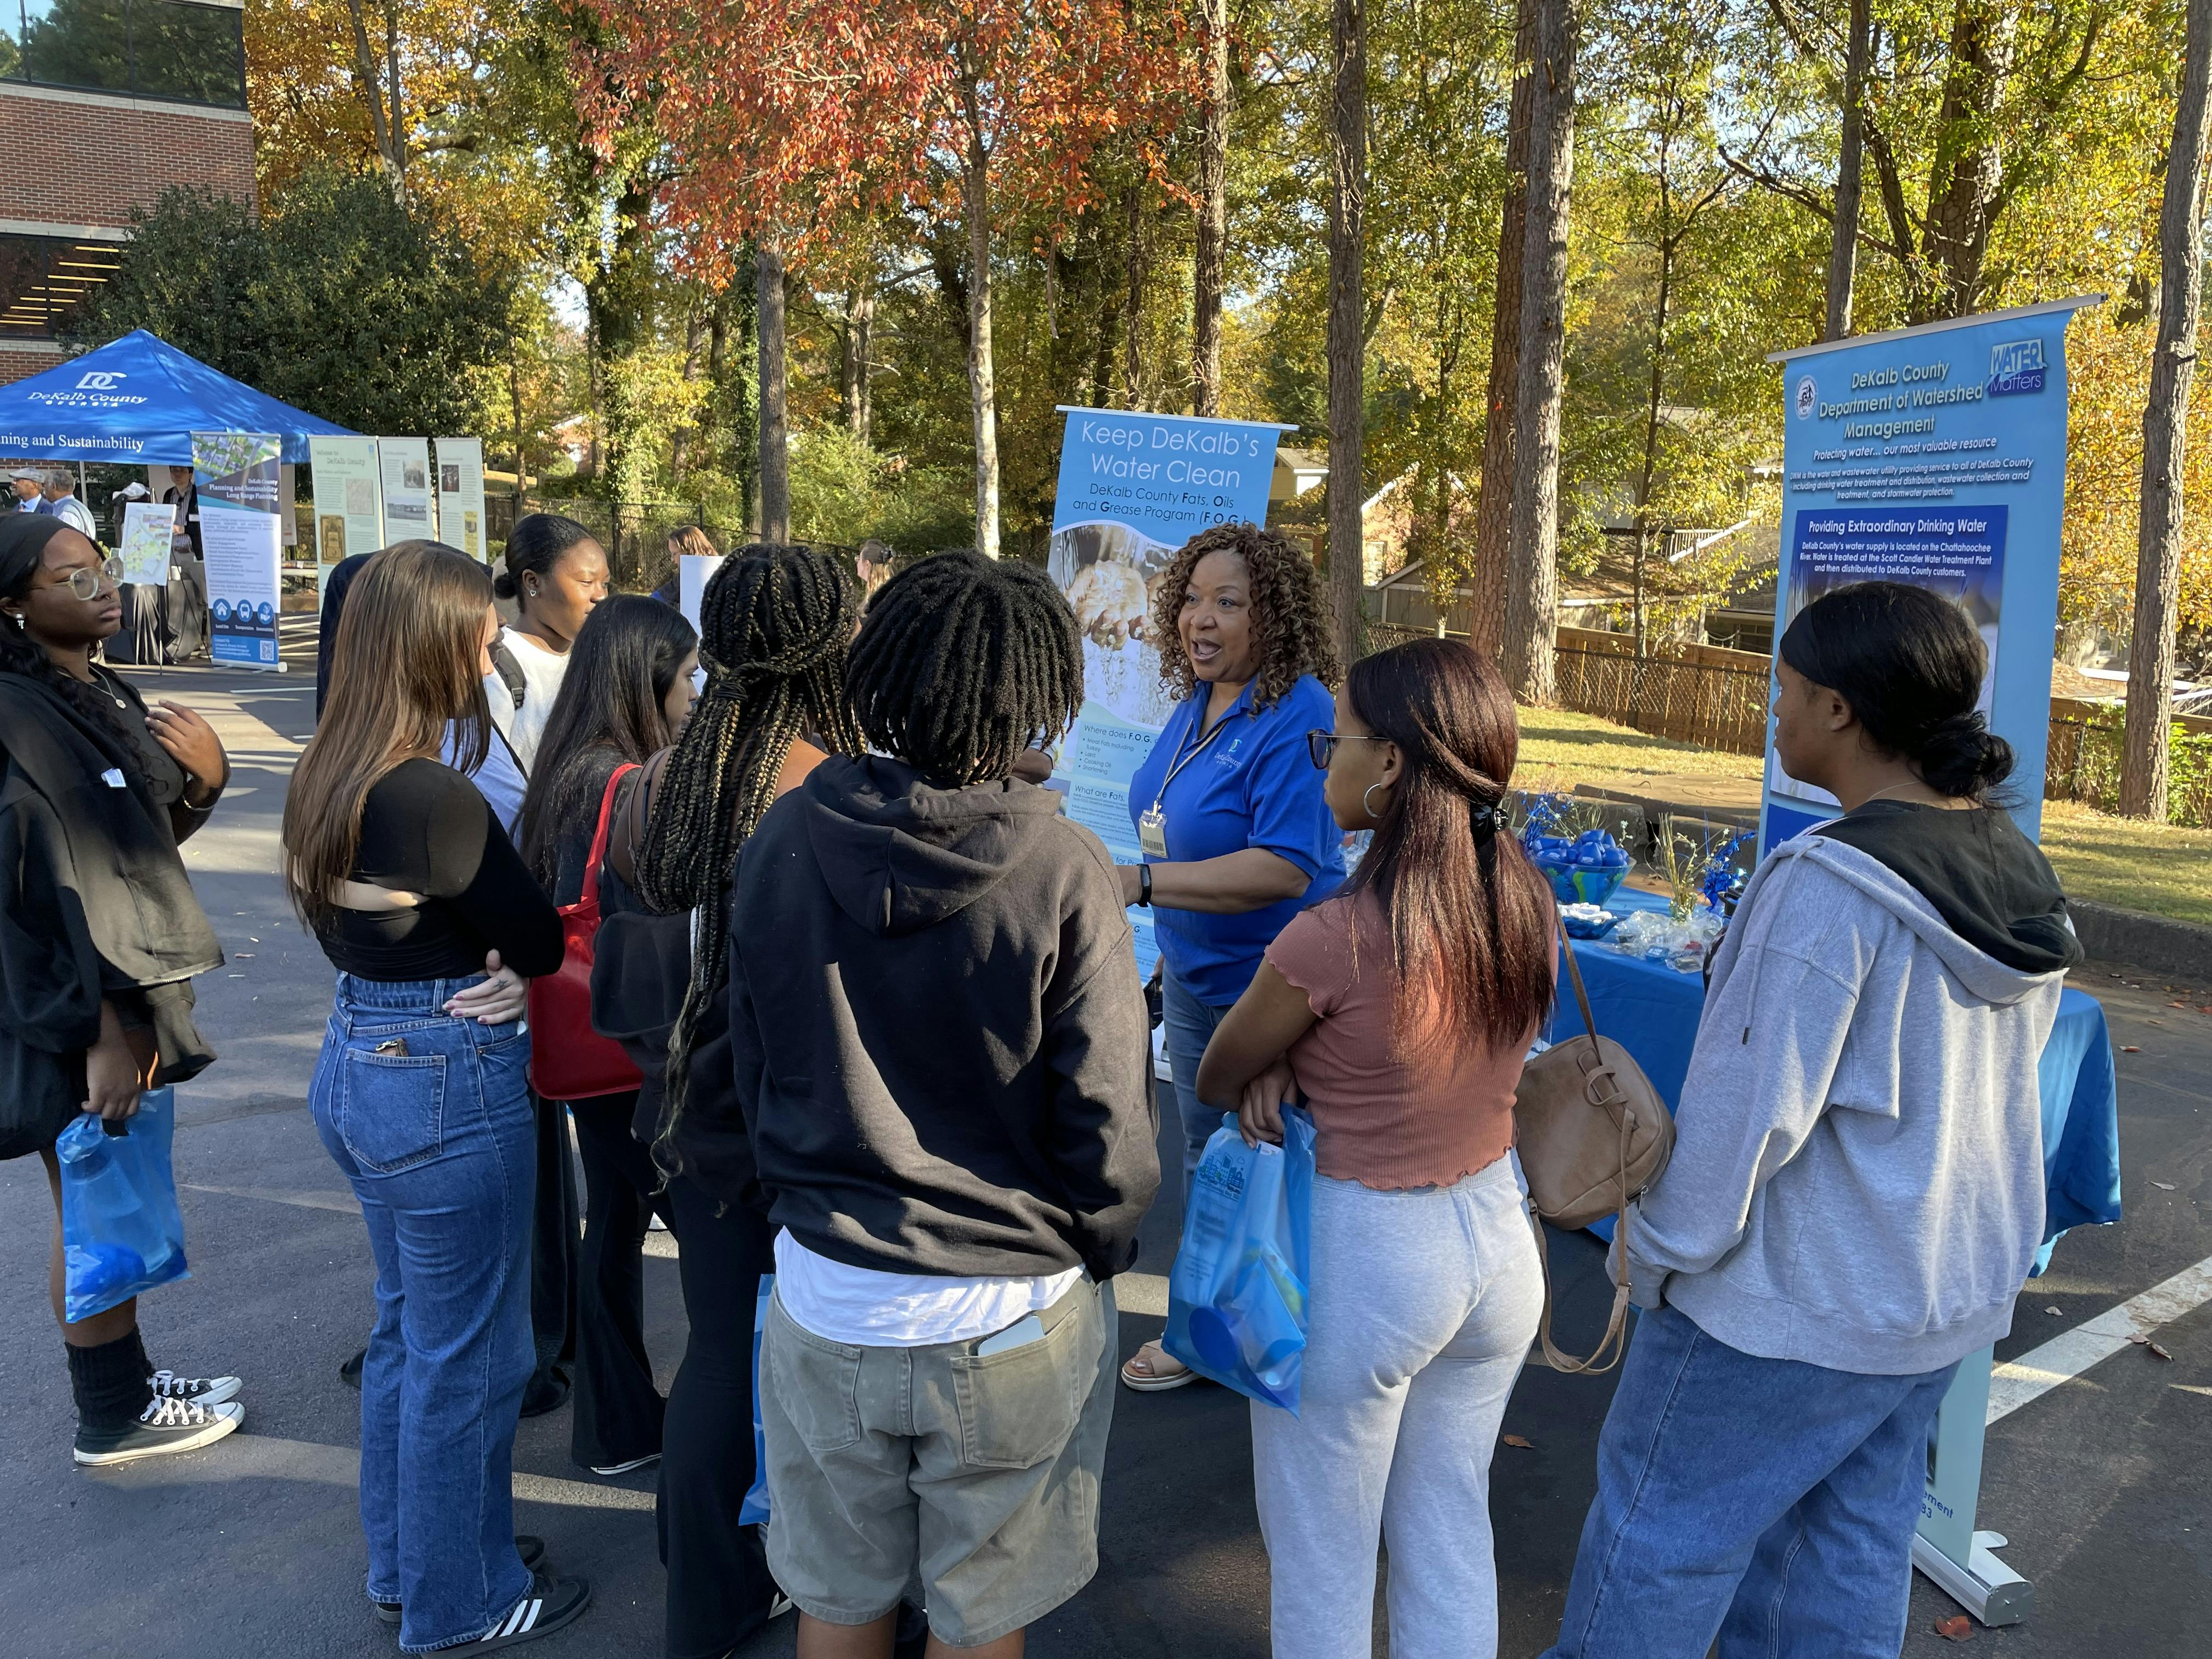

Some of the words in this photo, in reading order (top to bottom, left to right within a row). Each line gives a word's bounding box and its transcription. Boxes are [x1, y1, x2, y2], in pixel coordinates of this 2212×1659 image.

[1992, 342, 2040, 373] WATER
[1852, 366, 1898, 389] DeKalb
[1901, 360, 1950, 382] County
[1990, 373, 2042, 392] Matters
[27, 392, 86, 400] DeKalb
[89, 393, 148, 404] County
[1819, 393, 1892, 420] Department
[1896, 392, 1909, 409] of
[1912, 381, 1983, 407] Watershed
[1844, 415, 1935, 439] Management
[32, 434, 54, 447] and
[59, 435, 144, 453] Sustainability
[1082, 421, 1143, 452] Keep
[1152, 426, 1259, 457] DeKalb's
[1813, 448, 1846, 460] Protecting
[1848, 446, 1881, 457] water...
[1883, 445, 1898, 455] our
[1900, 441, 1920, 453] most
[1922, 438, 1957, 452] valuable
[1959, 437, 1997, 449] resource
[1092, 453, 1160, 479] Water
[1167, 460, 1240, 488] Clean
[1790, 472, 1801, 480] DWM
[1817, 470, 1830, 478] water
[1831, 469, 1841, 477] and
[1842, 466, 1879, 477] wastewater
[1881, 466, 1897, 475] utility
[1899, 463, 1928, 475] providing
[1929, 462, 1950, 472] service
[1951, 462, 1958, 470] to
[1960, 461, 1968, 470] all
[1970, 460, 1978, 470] of
[1978, 459, 2001, 469] DeKalb
[2003, 457, 2034, 469] County
[209, 484, 233, 492] Planning
[1817, 480, 1836, 489] drinking
[1836, 479, 1853, 488] water
[1854, 476, 1887, 487] treatment
[1889, 476, 1901, 485] and
[1903, 475, 1936, 485] distribution,
[1938, 474, 1975, 483] wastewater
[1977, 471, 2010, 482] collection
[2012, 470, 2030, 480] and
[255, 493, 278, 501] Planning
[1090, 483, 1132, 498] DeKalb
[1136, 488, 1178, 505] County
[1182, 492, 1208, 506] Fats,
[1214, 495, 1234, 508] Oils
[1837, 490, 1870, 499] treatment,
[1872, 490, 1886, 498] and
[1887, 487, 1921, 498] stormwater
[1923, 487, 1954, 498] protection.
[1073, 500, 1096, 511] and
[1101, 501, 1141, 516] Grease
[1145, 506, 1195, 522] Program
[1809, 520, 1845, 535] Providing
[1848, 519, 1915, 535] Extraordinary
[1917, 518, 1954, 535] Drinking
[1958, 518, 1987, 532] Water
[1802, 541, 1818, 550] DeKalb
[1819, 541, 1844, 551] County's
[1846, 542, 1865, 550] water
[1866, 542, 1888, 552] supply
[1889, 542, 1894, 551] is
[1896, 543, 1920, 551] located
[1930, 543, 1939, 551] the
[1940, 543, 1991, 552] Chattahoochee
[1813, 552, 1827, 561] Water
[1834, 553, 1858, 562] treated
[1869, 554, 1880, 562] the
[1881, 554, 1897, 562] Scott
[1899, 554, 1923, 563] Candler
[1925, 555, 1941, 563] Water
[1942, 555, 1974, 565] Treatment
[1975, 556, 1992, 565] Plant
[1826, 564, 1839, 572] then
[1841, 564, 1877, 573] distributed
[1878, 565, 1885, 573] to
[1887, 565, 1910, 574] DeKalb
[1911, 566, 1932, 577] County
[1933, 567, 1966, 577] customers.
[1084, 724, 1107, 735] Where
[1109, 730, 1126, 738] does
[1128, 732, 1152, 743] F.O.G.
[1111, 742, 1134, 752] Including
[1082, 765, 1108, 775] Shortening
[1084, 758, 1104, 768] Cooking
[1075, 785, 1093, 794] What
[1116, 856, 1125, 865] for
